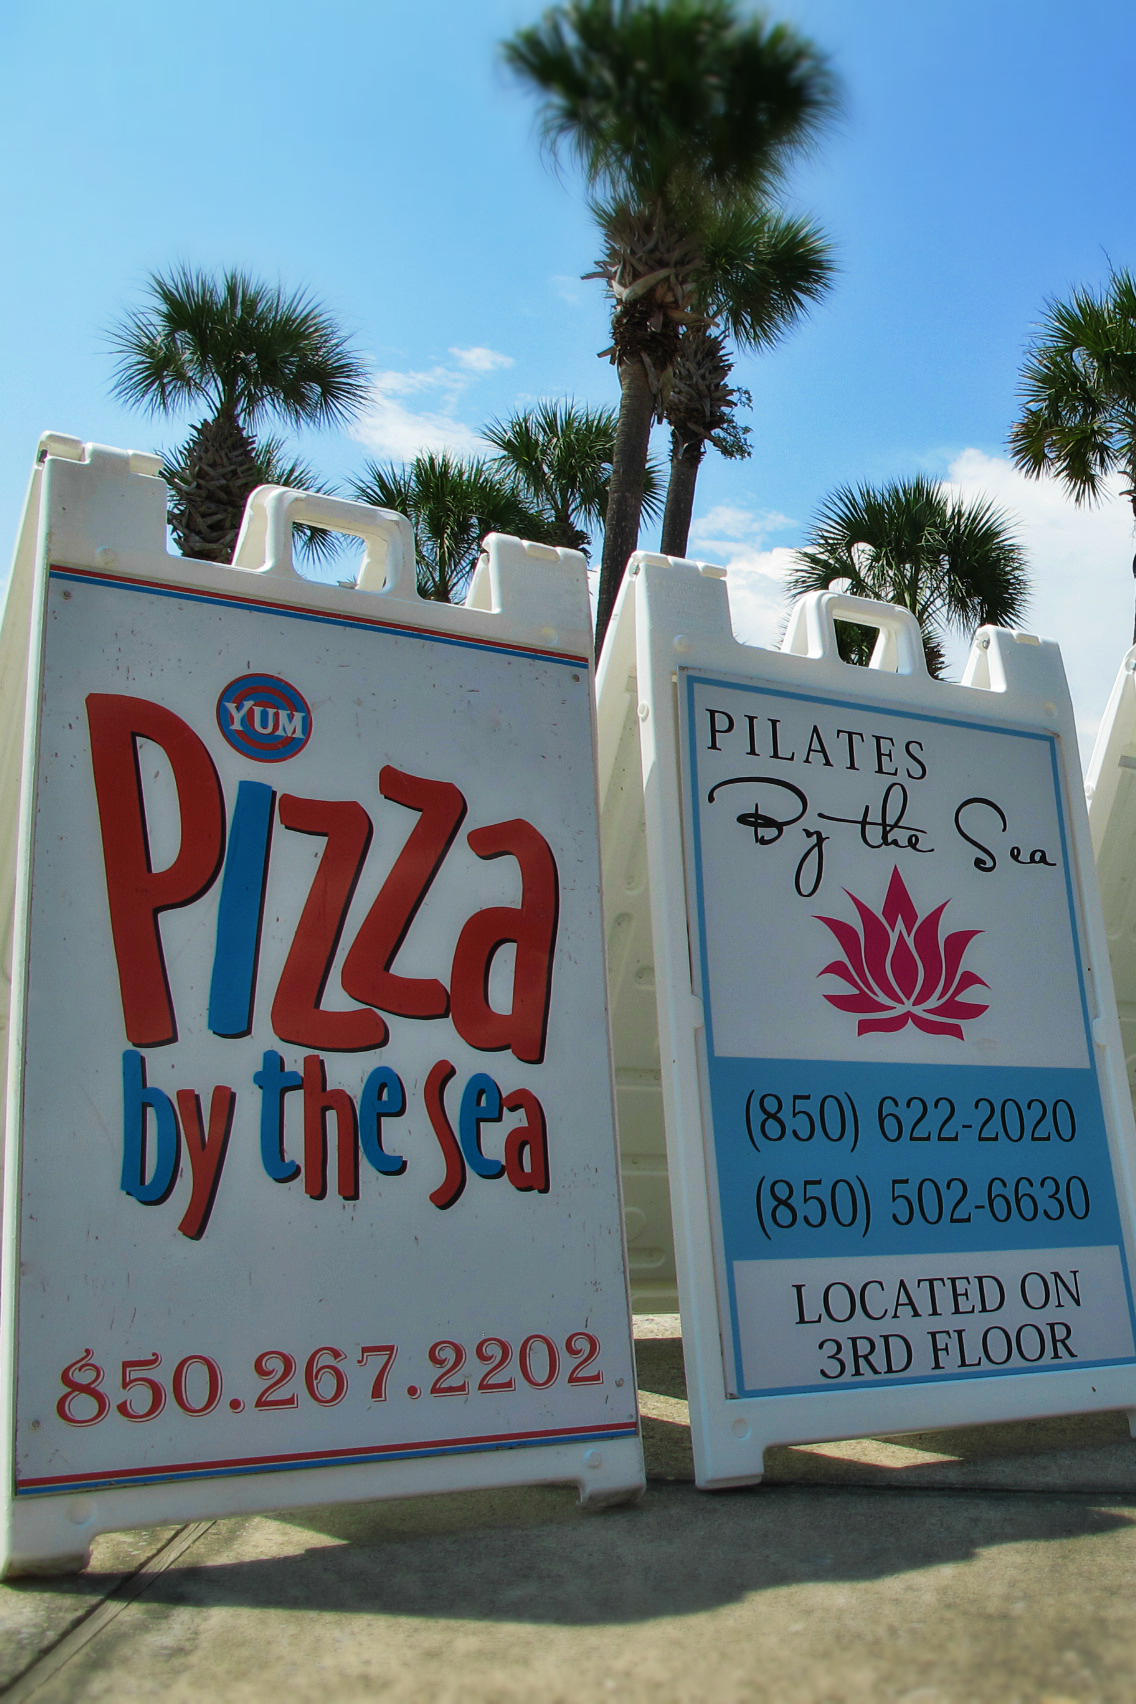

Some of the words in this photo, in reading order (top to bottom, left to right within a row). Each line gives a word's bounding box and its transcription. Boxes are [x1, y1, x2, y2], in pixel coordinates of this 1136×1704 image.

[224, 700, 307, 739] YUM
[705, 708, 928, 782] PILATES
[707, 776, 831, 897] By
[818, 782, 935, 853] the
[954, 797, 1057, 873] Sea
[121, 1050, 236, 1240] by
[253, 1049, 407, 1202] the
[745, 1089, 860, 1152] (850)
[877, 1096, 1078, 1143] 622-2020
[755, 1174, 873, 1240] (850)
[891, 1174, 1091, 1224] 502-6630
[792, 1276, 1006, 1325] LOCATED
[1020, 1270, 1082, 1311] ON
[55, 1331, 604, 1429] 850.267.2202
[818, 1333, 913, 1380] 3RD
[927, 1322, 1077, 1371] FLOOR
